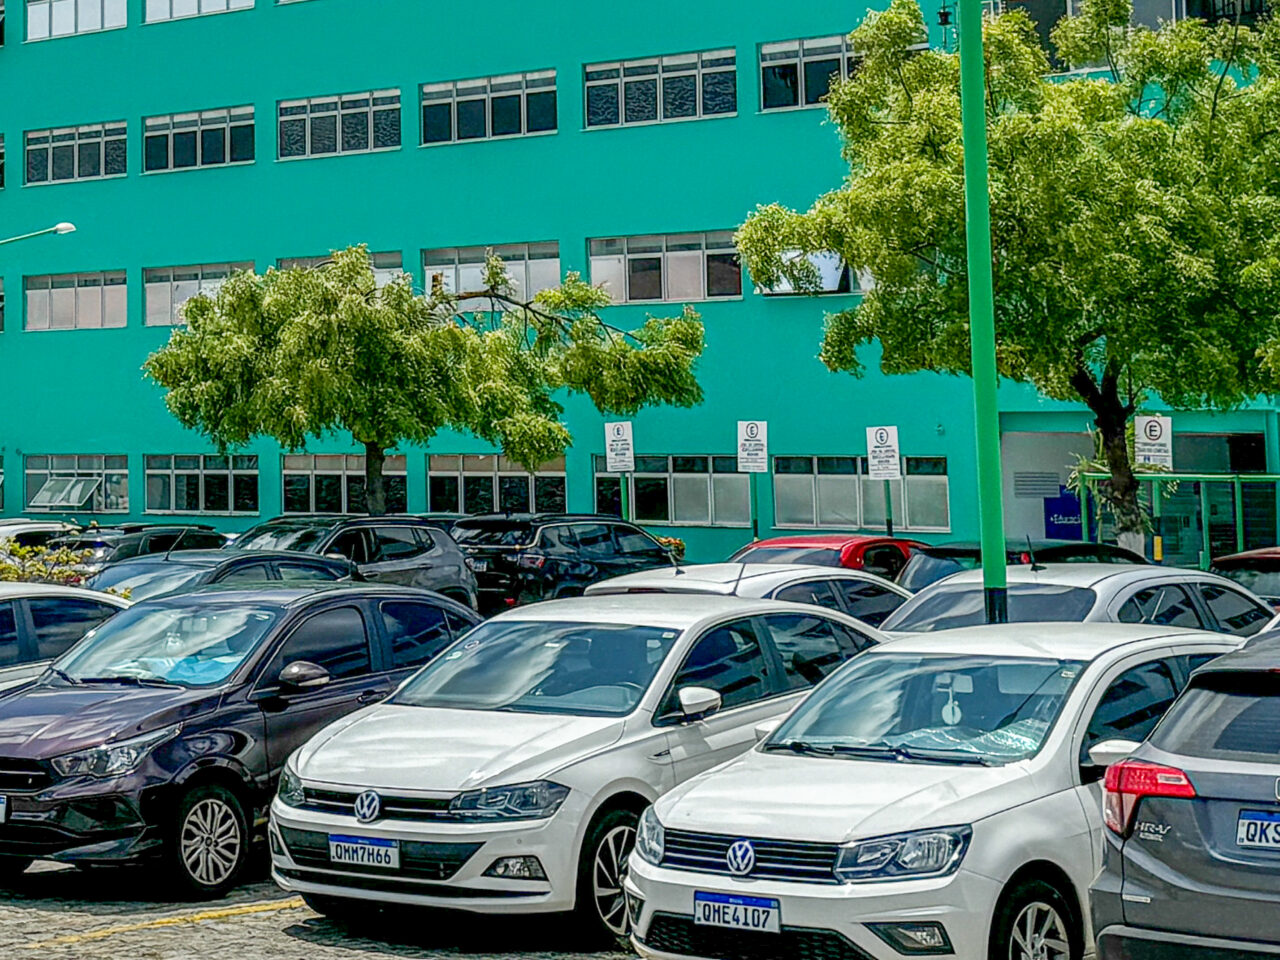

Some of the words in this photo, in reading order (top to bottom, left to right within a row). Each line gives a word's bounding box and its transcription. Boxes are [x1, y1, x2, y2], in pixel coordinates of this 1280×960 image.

[1134, 821, 1172, 835] HR-V
[335, 844, 392, 865] QMM7H66
[702, 903, 771, 929] QME4I07
